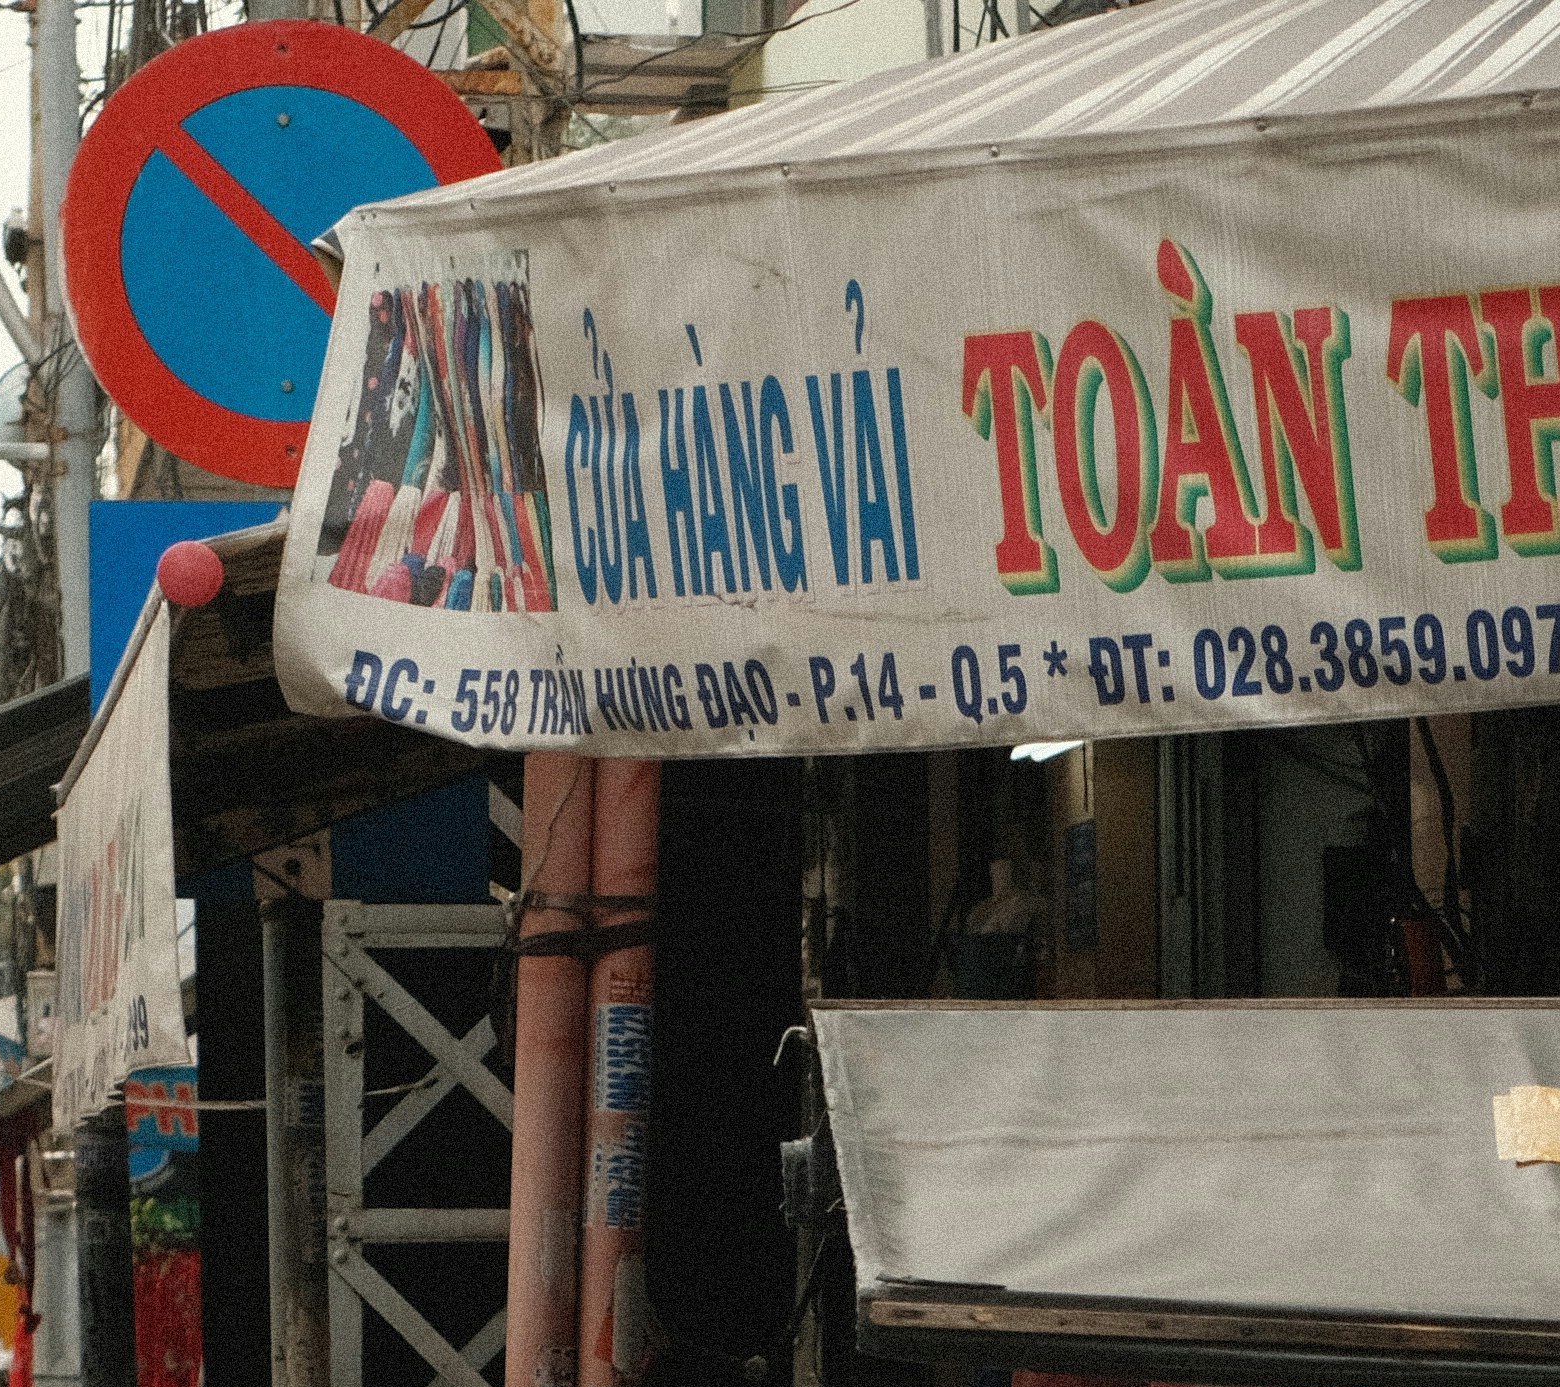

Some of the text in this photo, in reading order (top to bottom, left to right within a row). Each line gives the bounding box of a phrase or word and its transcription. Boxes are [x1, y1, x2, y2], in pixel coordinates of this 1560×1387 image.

[564, 280, 922, 606] CỬA HÀNG VẢI
[962, 235, 1364, 594] TOÀN
[344, 650, 436, 724] ĐC:
[451, 668, 520, 736] 558
[527, 643, 594, 737] TRẦN
[593, 656, 693, 734] HƯNG
[694, 658, 778, 741] ĐẠO
[809, 652, 904, 724] P.14
[950, 643, 1028, 725] Q.5
[1088, 633, 1175, 706] ĐT:
